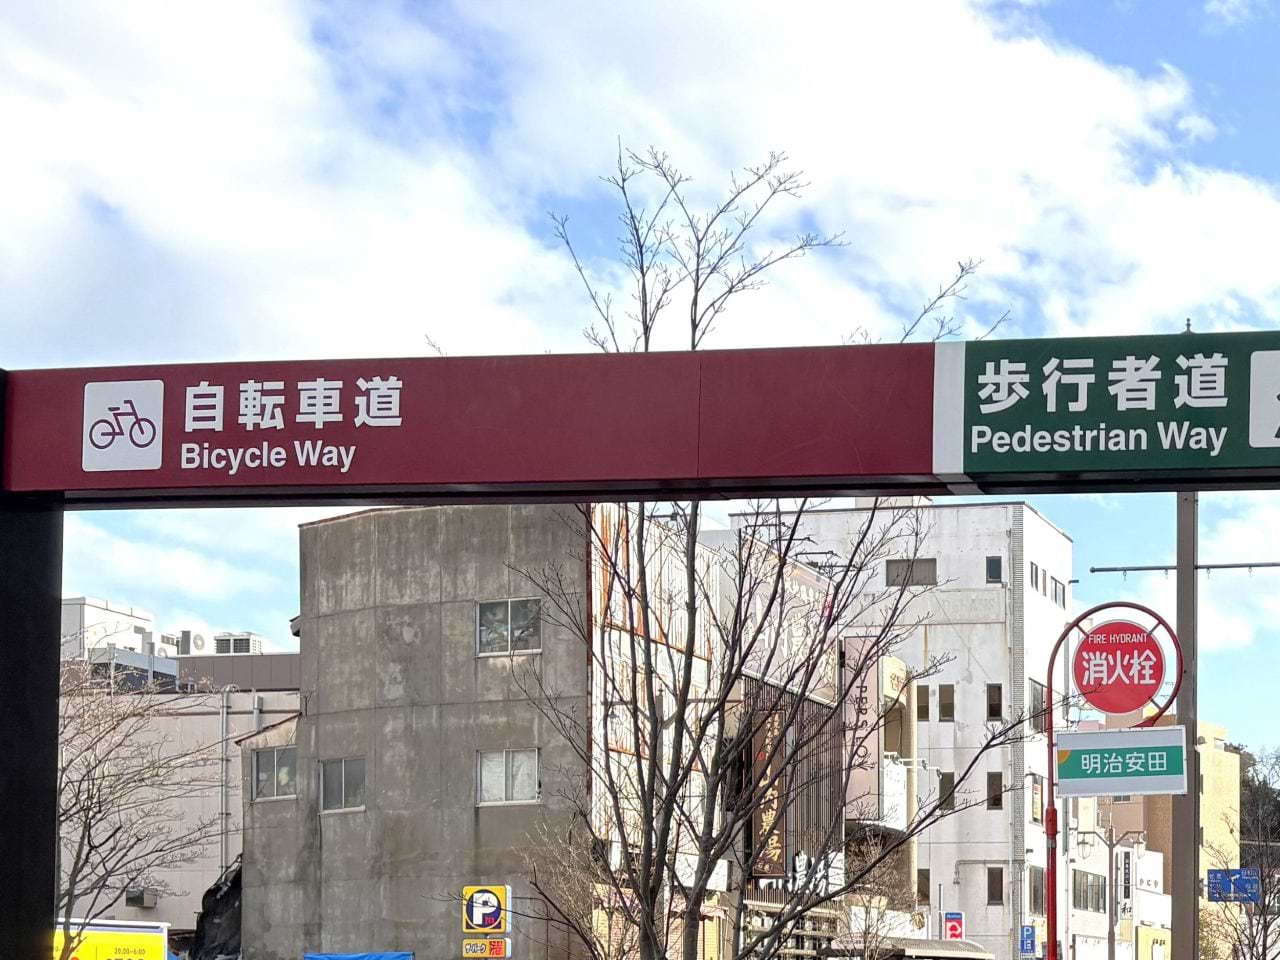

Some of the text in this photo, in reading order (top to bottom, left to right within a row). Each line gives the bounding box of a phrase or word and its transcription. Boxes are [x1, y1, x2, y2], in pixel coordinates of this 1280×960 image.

[977, 353, 1229, 414] 歩行者道
[185, 376, 403, 433] 自転車道
[971, 421, 1228, 457] Pedestrian Way
[181, 440, 356, 475] Bicycle Way
[1088, 633, 1148, 644] FIRE HYDRANT
[1081, 649, 1157, 686] 消火栓
[1081, 751, 1167, 774] 明治安田
